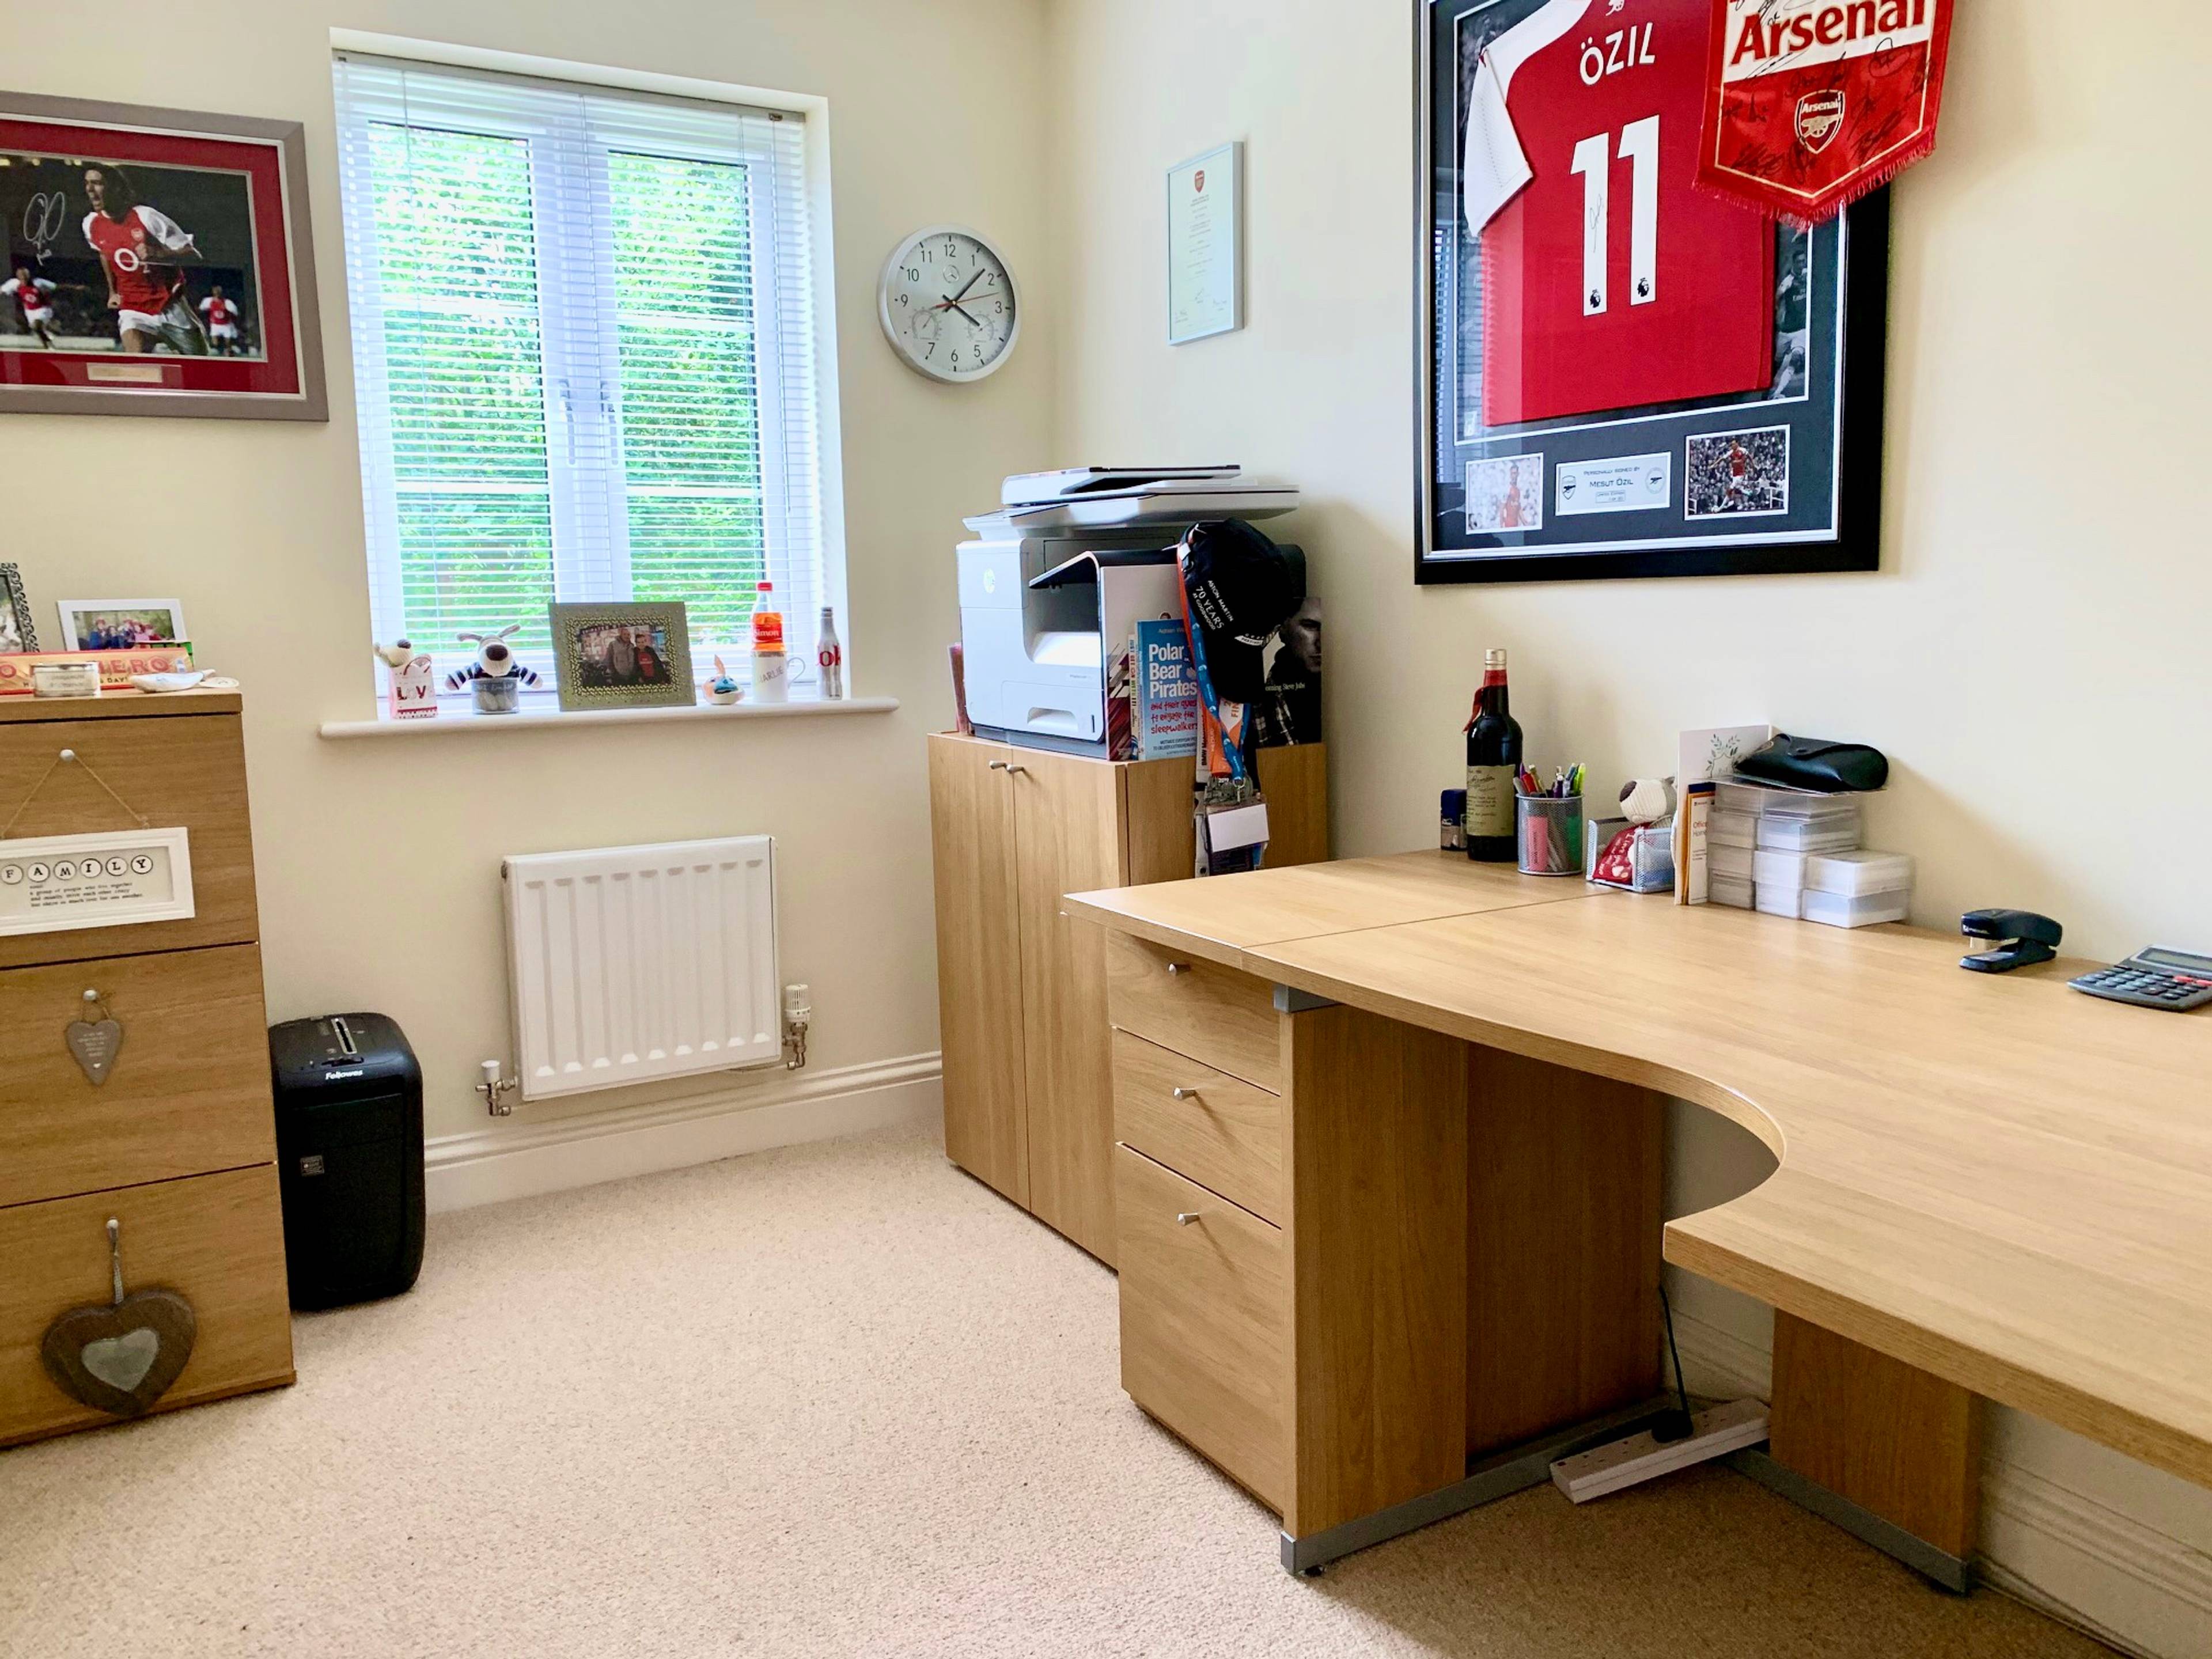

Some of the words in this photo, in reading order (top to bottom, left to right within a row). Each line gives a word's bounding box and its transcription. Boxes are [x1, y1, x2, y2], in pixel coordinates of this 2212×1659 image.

[1729, 0, 1926, 67] Arsenal
[1580, 22, 1656, 86] ÖZIL
[1801, 100, 1840, 115] Arsenal
[1570, 114, 1660, 317] 11
[921, 251, 932, 263] 11
[944, 244, 956, 257] 12
[971, 253, 975, 267] 1
[907, 268, 919, 282] 10
[988, 273, 995, 286] 2
[900, 294, 908, 307] 9
[995, 301, 1002, 314] 3
[928, 342, 935, 355] 7
[951, 349, 959, 362] 6
[974, 344, 980, 357] 5
[1616, 478, 1634, 486] ÖZIL
[1196, 586, 1206, 599] 70
[1204, 599, 1224, 628] YEARS
[1208, 580, 1219, 599] ASTON
[1218, 599, 1234, 622] MARTIN
[1149, 643, 1184, 661] Polar
[1149, 662, 1182, 680] Bear
[1150, 680, 1197, 699] Pirates
[6, 859, 145, 878] FAMILY
[325, 1070, 363, 1080] Fellowes
